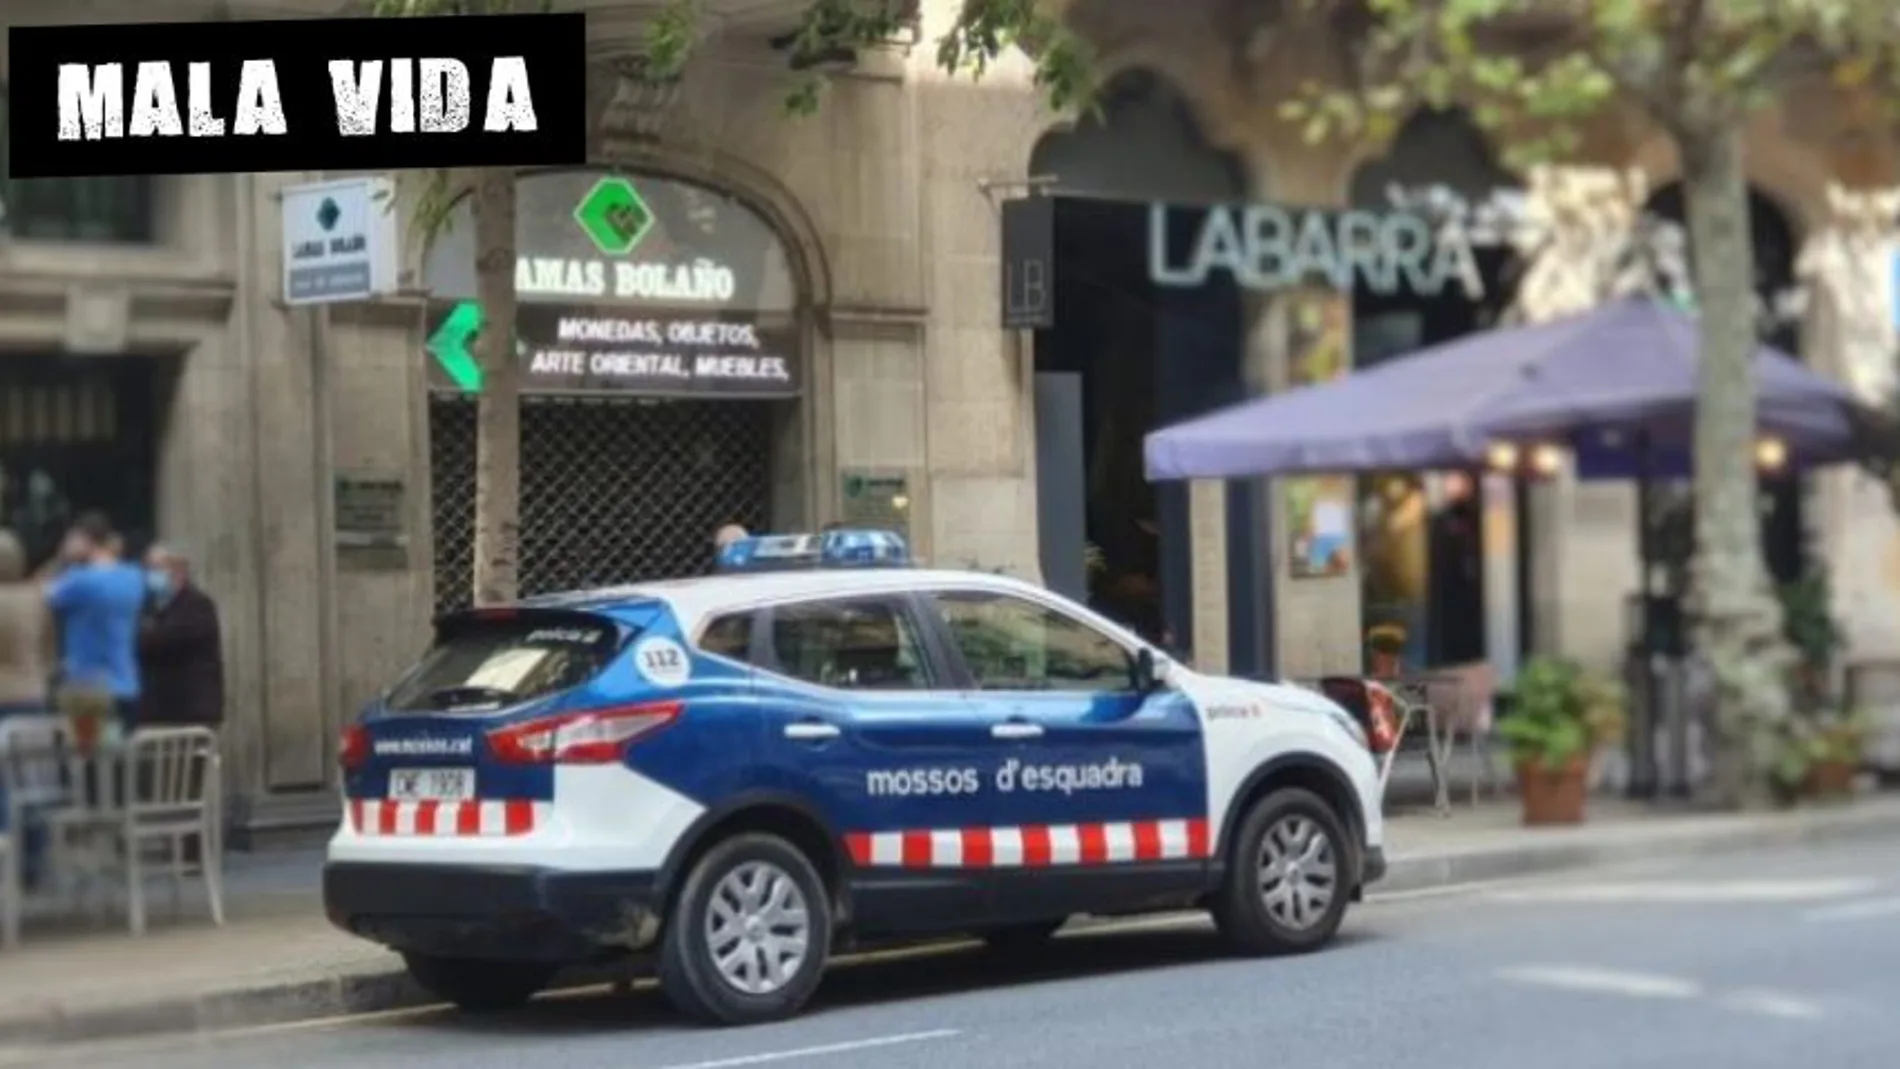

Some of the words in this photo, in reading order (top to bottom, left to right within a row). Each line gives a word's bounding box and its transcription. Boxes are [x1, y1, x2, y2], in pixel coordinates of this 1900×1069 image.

[1149, 201, 1484, 298] LABARRA
[515, 257, 605, 295] AMAS
[615, 257, 735, 300] BOLAÑO
[558, 316, 663, 346] MONEDAS,
[667, 322, 760, 349] OBJETOS,
[530, 350, 587, 374] ARTE
[695, 356, 790, 382] MUEBLES,
[643, 648, 680, 668] 112
[867, 765, 978, 797] mossos
[996, 756, 1144, 794] d'esquadra
